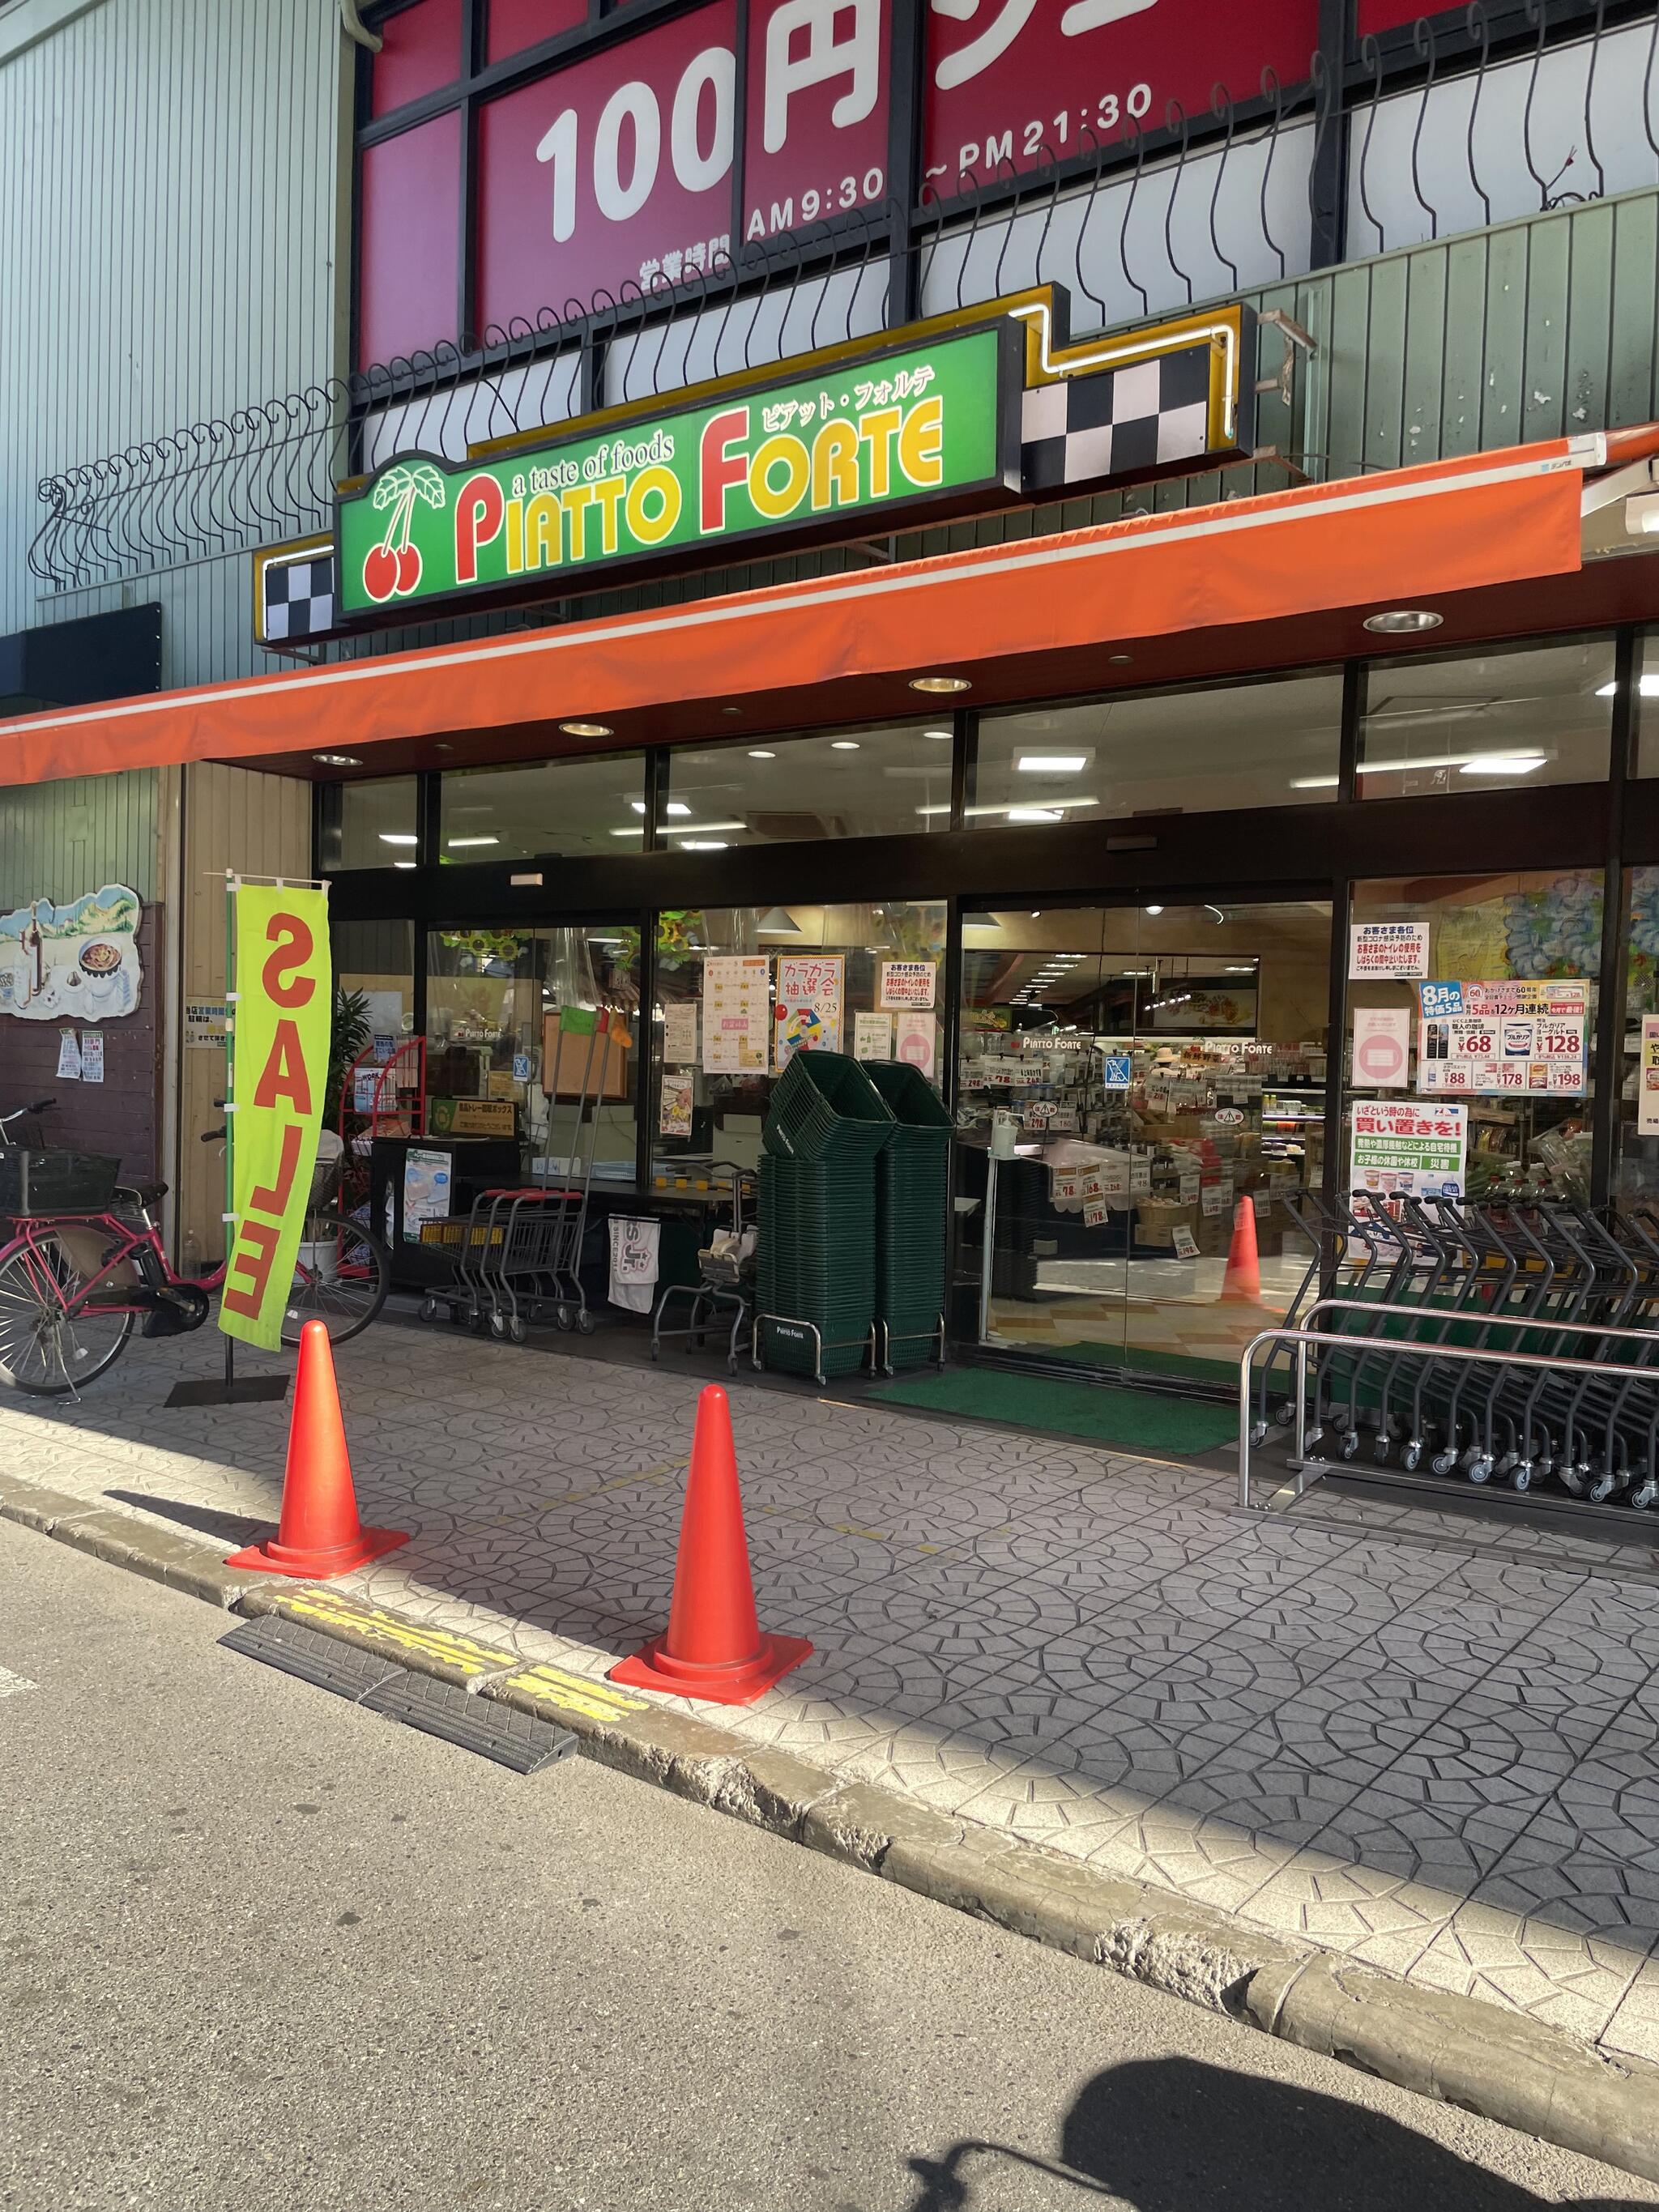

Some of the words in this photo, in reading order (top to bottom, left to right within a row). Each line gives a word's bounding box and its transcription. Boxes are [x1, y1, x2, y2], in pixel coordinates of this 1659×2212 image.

[639, 233, 730, 291] 営業時間
[747, 168, 884, 241] AM9:30
[761, 364, 935, 433] ピアット・フォルテ
[512, 474, 526, 497] a
[530, 461, 579, 492] taste
[583, 445, 609, 479] of
[612, 429, 675, 473] foods
[455, 464, 683, 584] PIATTO
[699, 394, 944, 535] FORTE
[1363, 926, 1414, 935] お客さま各位
[1357, 943, 1422, 954] お客さまのトイレの使用を
[784, 961, 836, 978] ガラガラ
[785, 977, 835, 996] 抽選会
[1422, 985, 1460, 1006] 8月の
[813, 1002, 838, 1013] 8/25
[1023, 1037, 1053, 1050] PIATTO
[1054, 1037, 1081, 1050] FORTE
[1357, 1106, 1420, 1117] いざという時の為に
[1356, 1117, 1461, 1137] 買い置きを!
[1430, 1157, 1450, 1170] 災害
